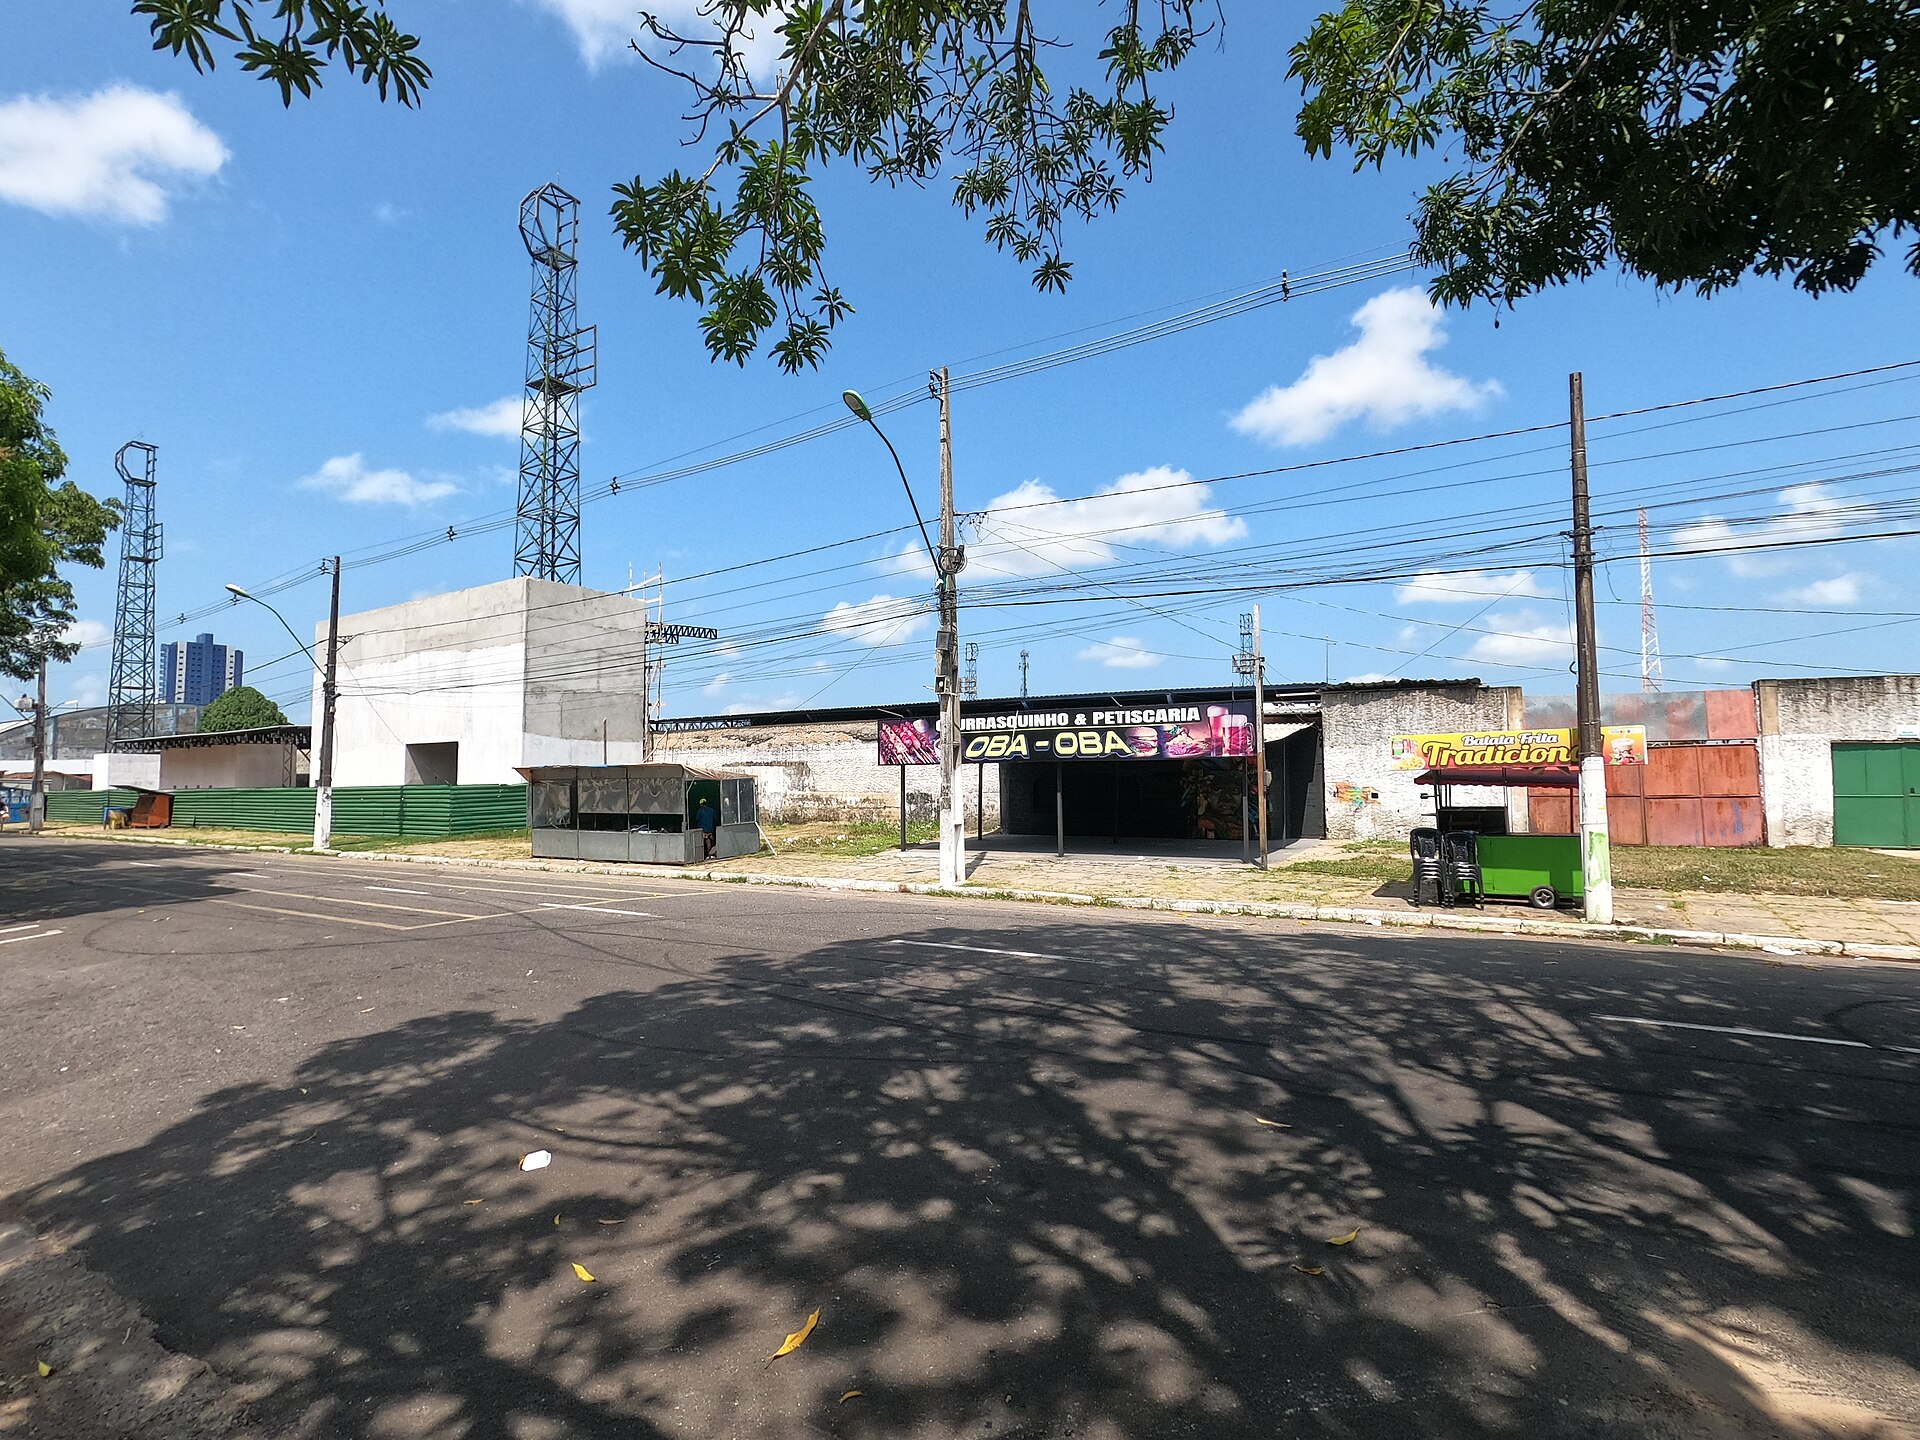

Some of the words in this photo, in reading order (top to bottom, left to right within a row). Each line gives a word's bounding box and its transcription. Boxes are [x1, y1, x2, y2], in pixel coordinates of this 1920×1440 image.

[935, 712, 1069, 732] URRASQUINHO
[1074, 713, 1087, 725] &
[1092, 707, 1201, 725] PETISCARIA
[965, 733, 1029, 758] OBA
[1054, 730, 1133, 756] OBA
[1461, 735, 1515, 747] Batata
[1517, 731, 1559, 745] Frita
[1421, 740, 1604, 767] Tradicion
